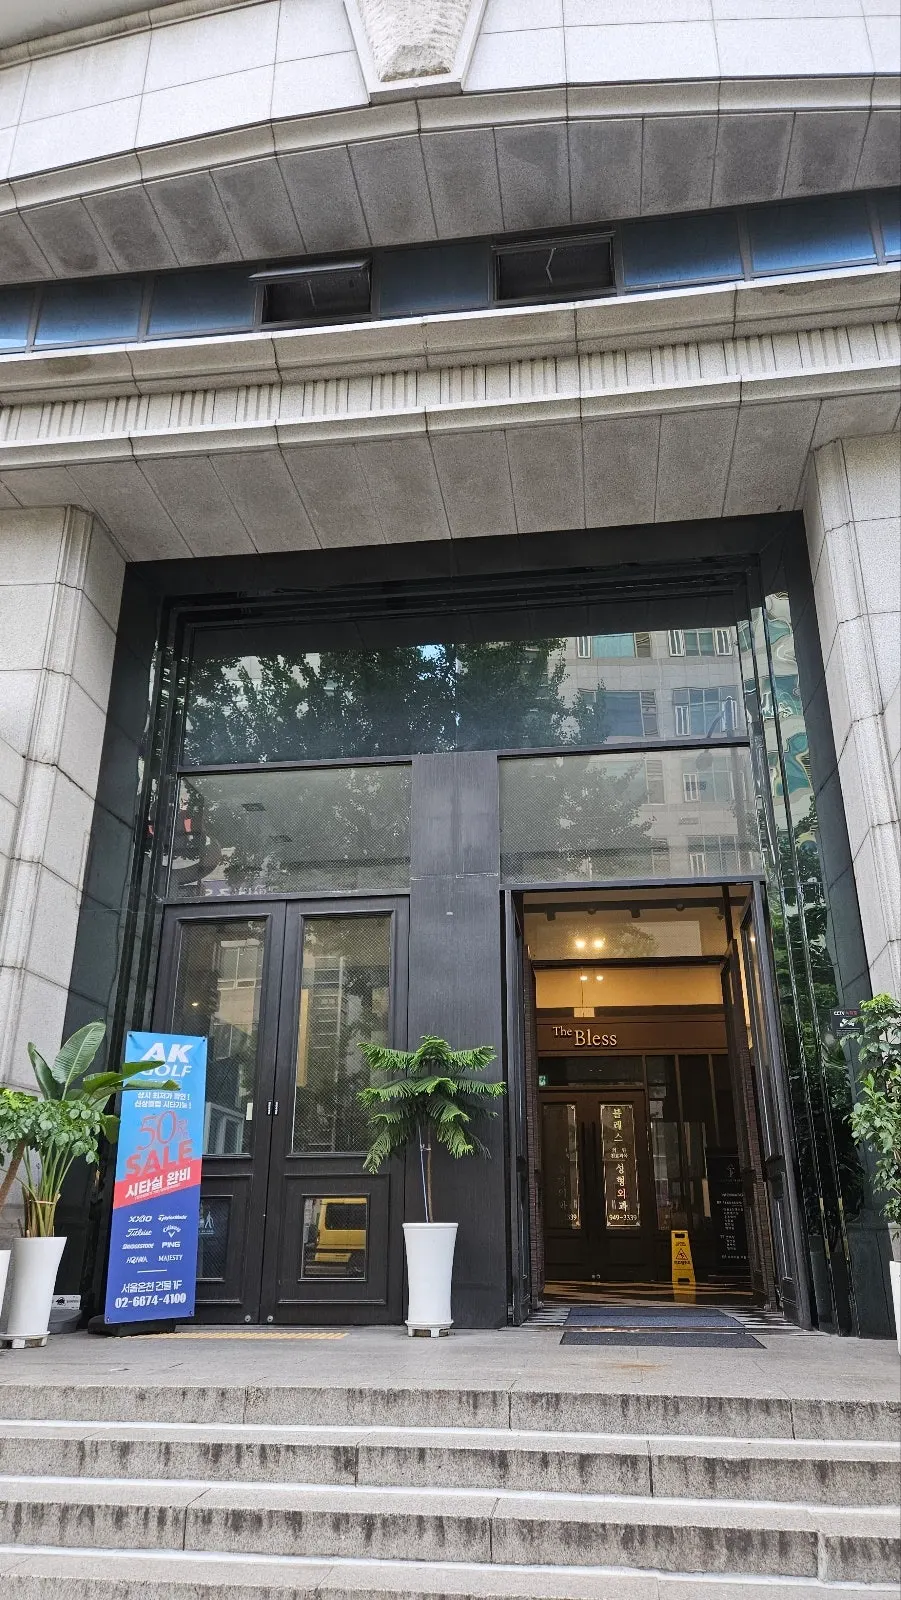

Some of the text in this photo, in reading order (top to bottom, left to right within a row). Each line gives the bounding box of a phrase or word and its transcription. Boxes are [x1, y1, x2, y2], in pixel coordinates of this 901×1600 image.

[552, 1025, 617, 1046] The Bless
[140, 1042, 193, 1063] AK
[126, 1140, 193, 1178] SALE
[125, 1175, 163, 1198] 시타실
[166, 1167, 191, 1187] 완비
[616, 1163, 628, 1212] 성형외과
[121, 1281, 155, 1293] 서울온천
[155, 1280, 172, 1291] 건물
[115, 1292, 187, 1309] 02-6674-4100
